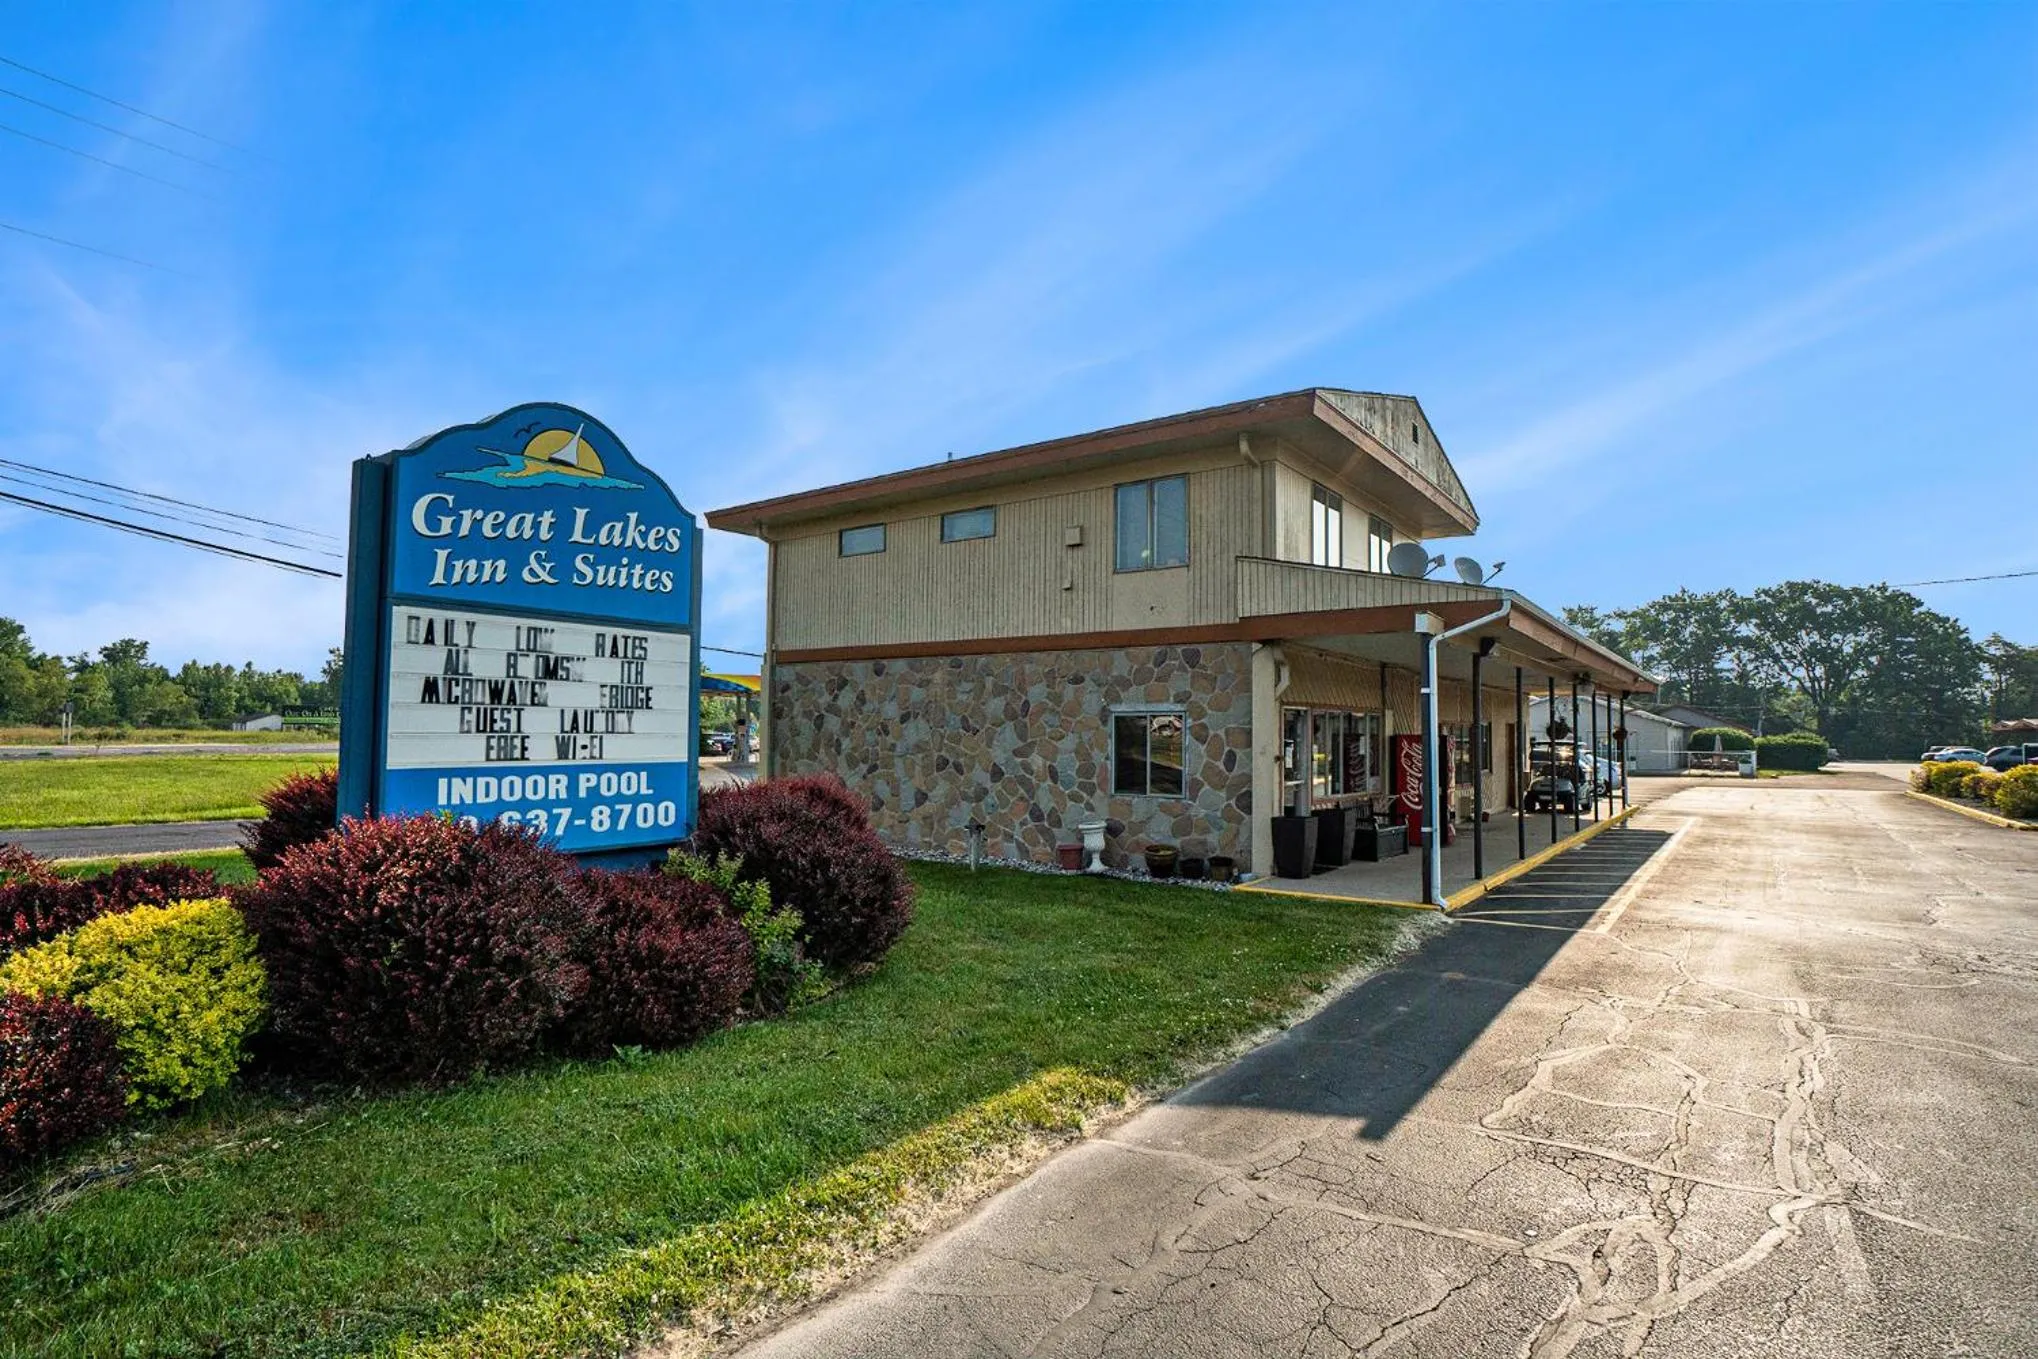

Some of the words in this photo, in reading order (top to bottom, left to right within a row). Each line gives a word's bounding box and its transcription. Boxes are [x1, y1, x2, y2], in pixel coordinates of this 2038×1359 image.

[411, 493, 556, 541] Great
[569, 506, 681, 552] Lakes
[429, 548, 507, 586] Inn
[522, 550, 559, 584] &
[573, 553, 674, 592] Suites
[459, 706, 525, 734] GUEST
[437, 774, 569, 806] INDOOR
[578, 771, 654, 798] POOL
